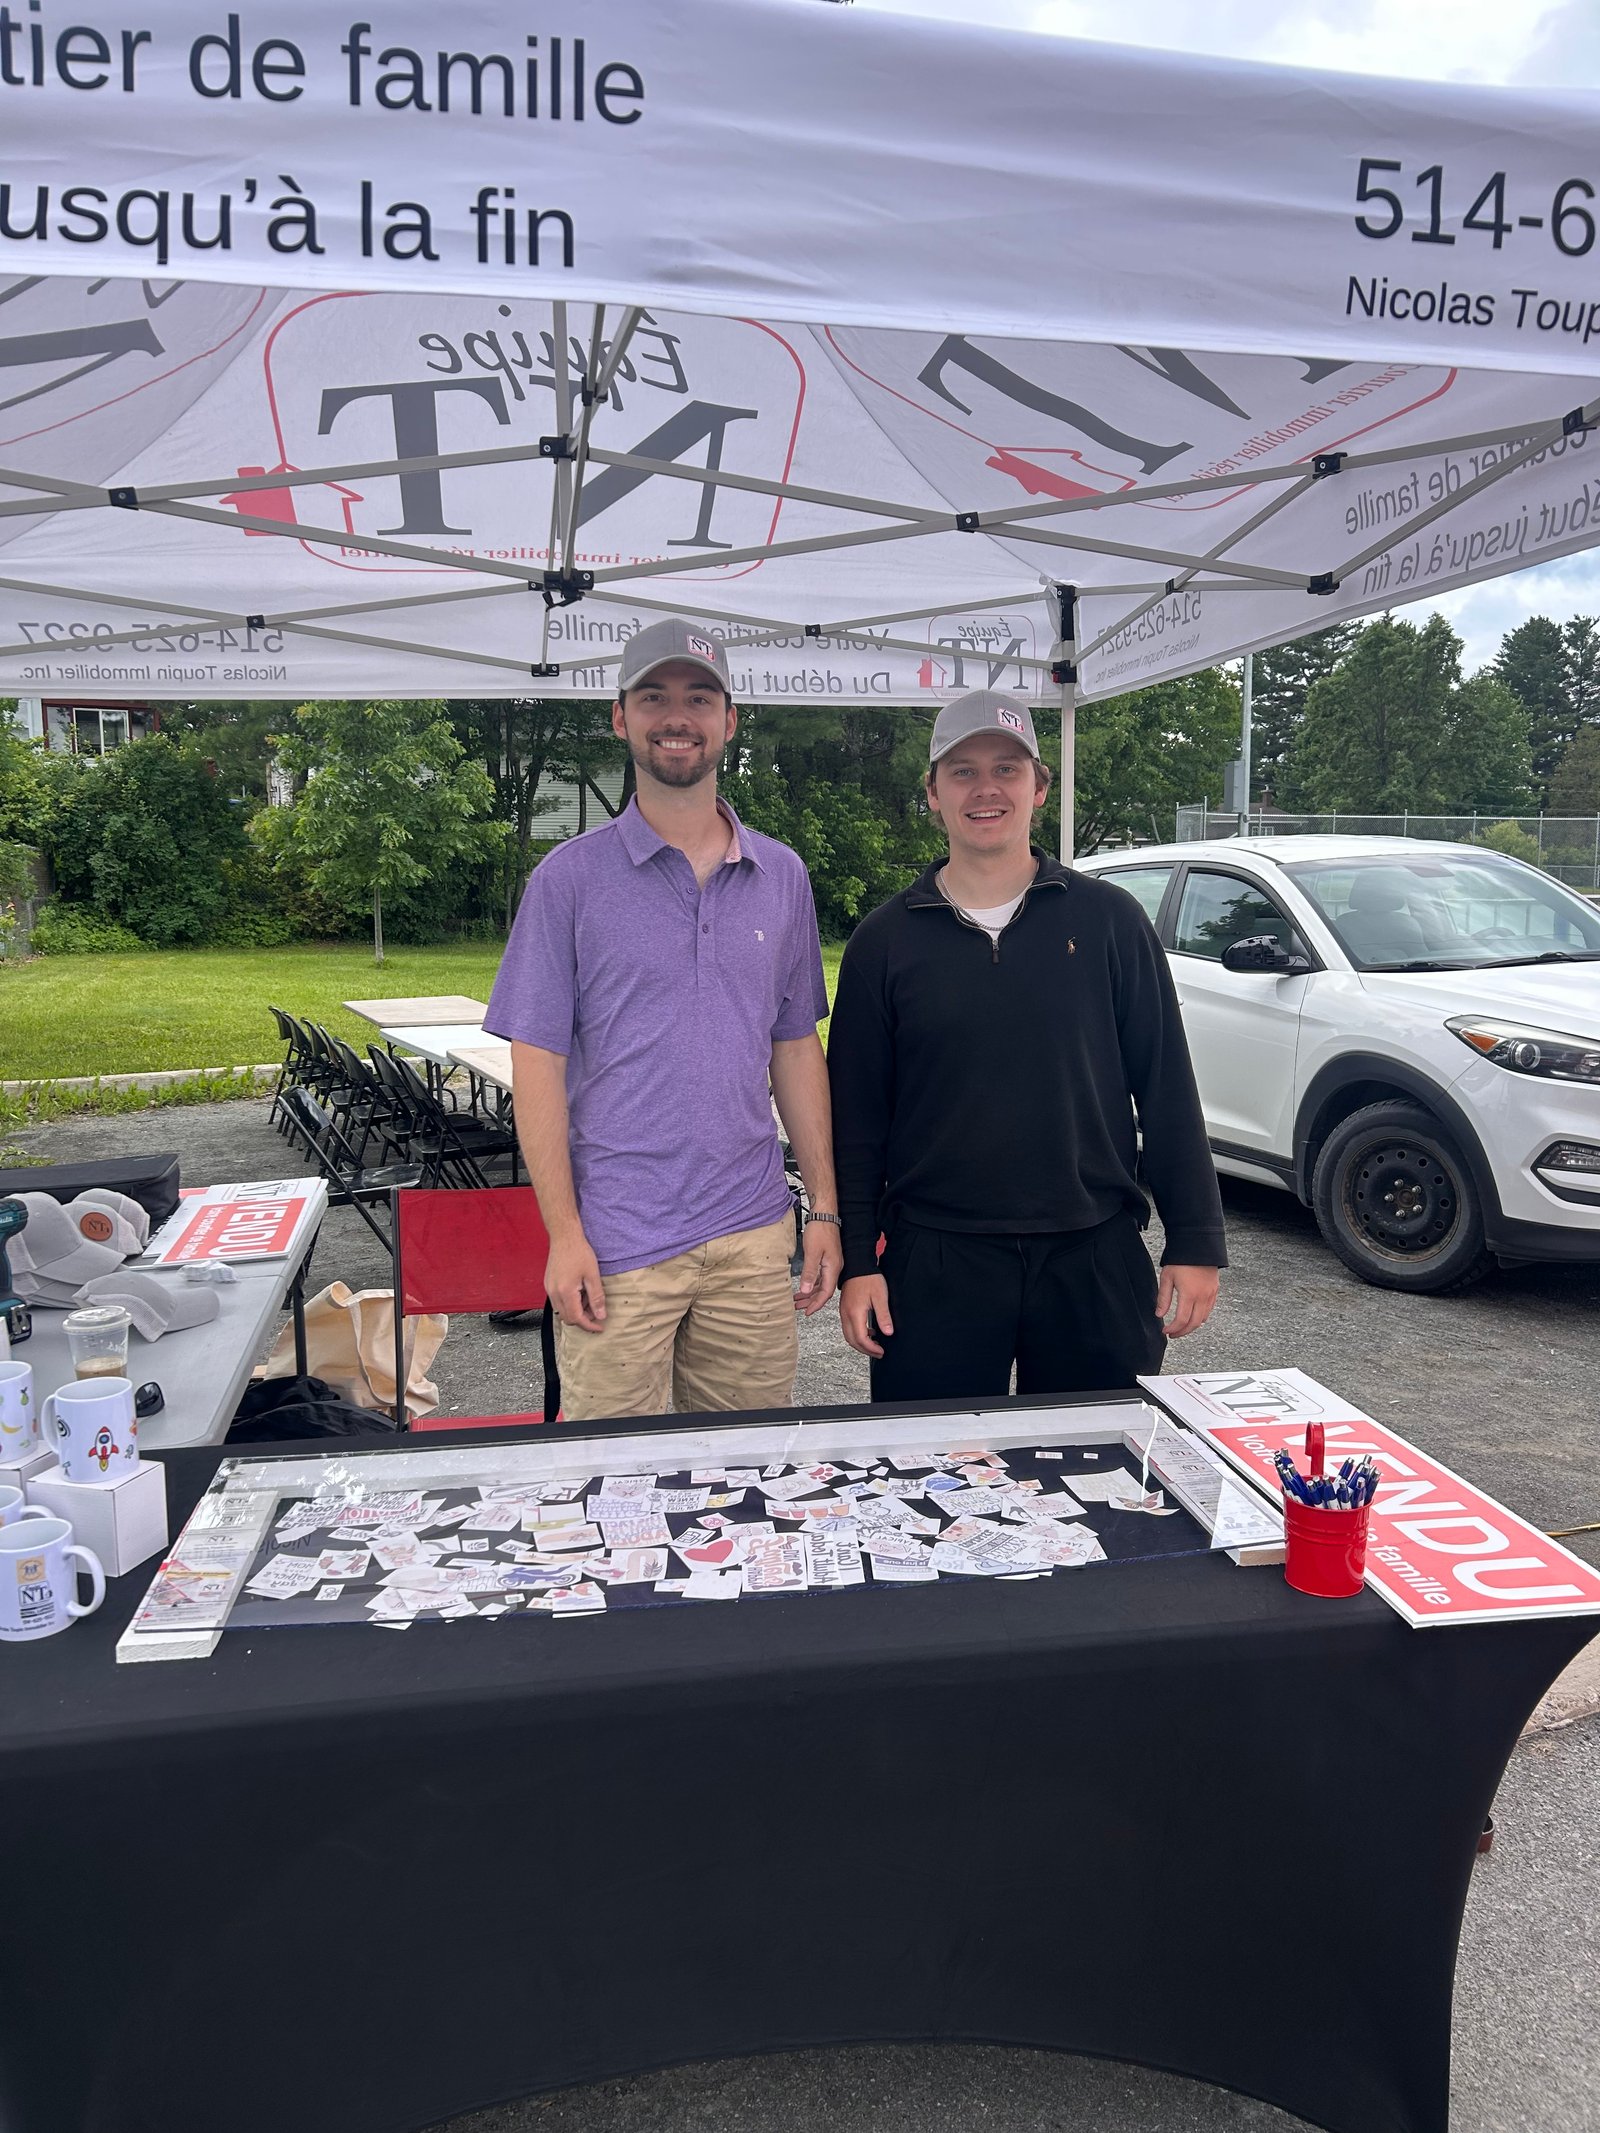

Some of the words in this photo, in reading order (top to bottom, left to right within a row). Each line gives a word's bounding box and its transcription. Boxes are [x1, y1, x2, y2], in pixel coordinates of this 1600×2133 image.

[188, 13, 307, 102] de
[340, 22, 645, 125] famille
[360, 180, 440, 262] la
[468, 187, 576, 268] fin
[1345, 275, 1497, 326] Nicolas
[208, 1199, 291, 1256] VENDU
[1193, 1376, 1297, 1413] NT
[1369, 1545, 1453, 1606] famille
